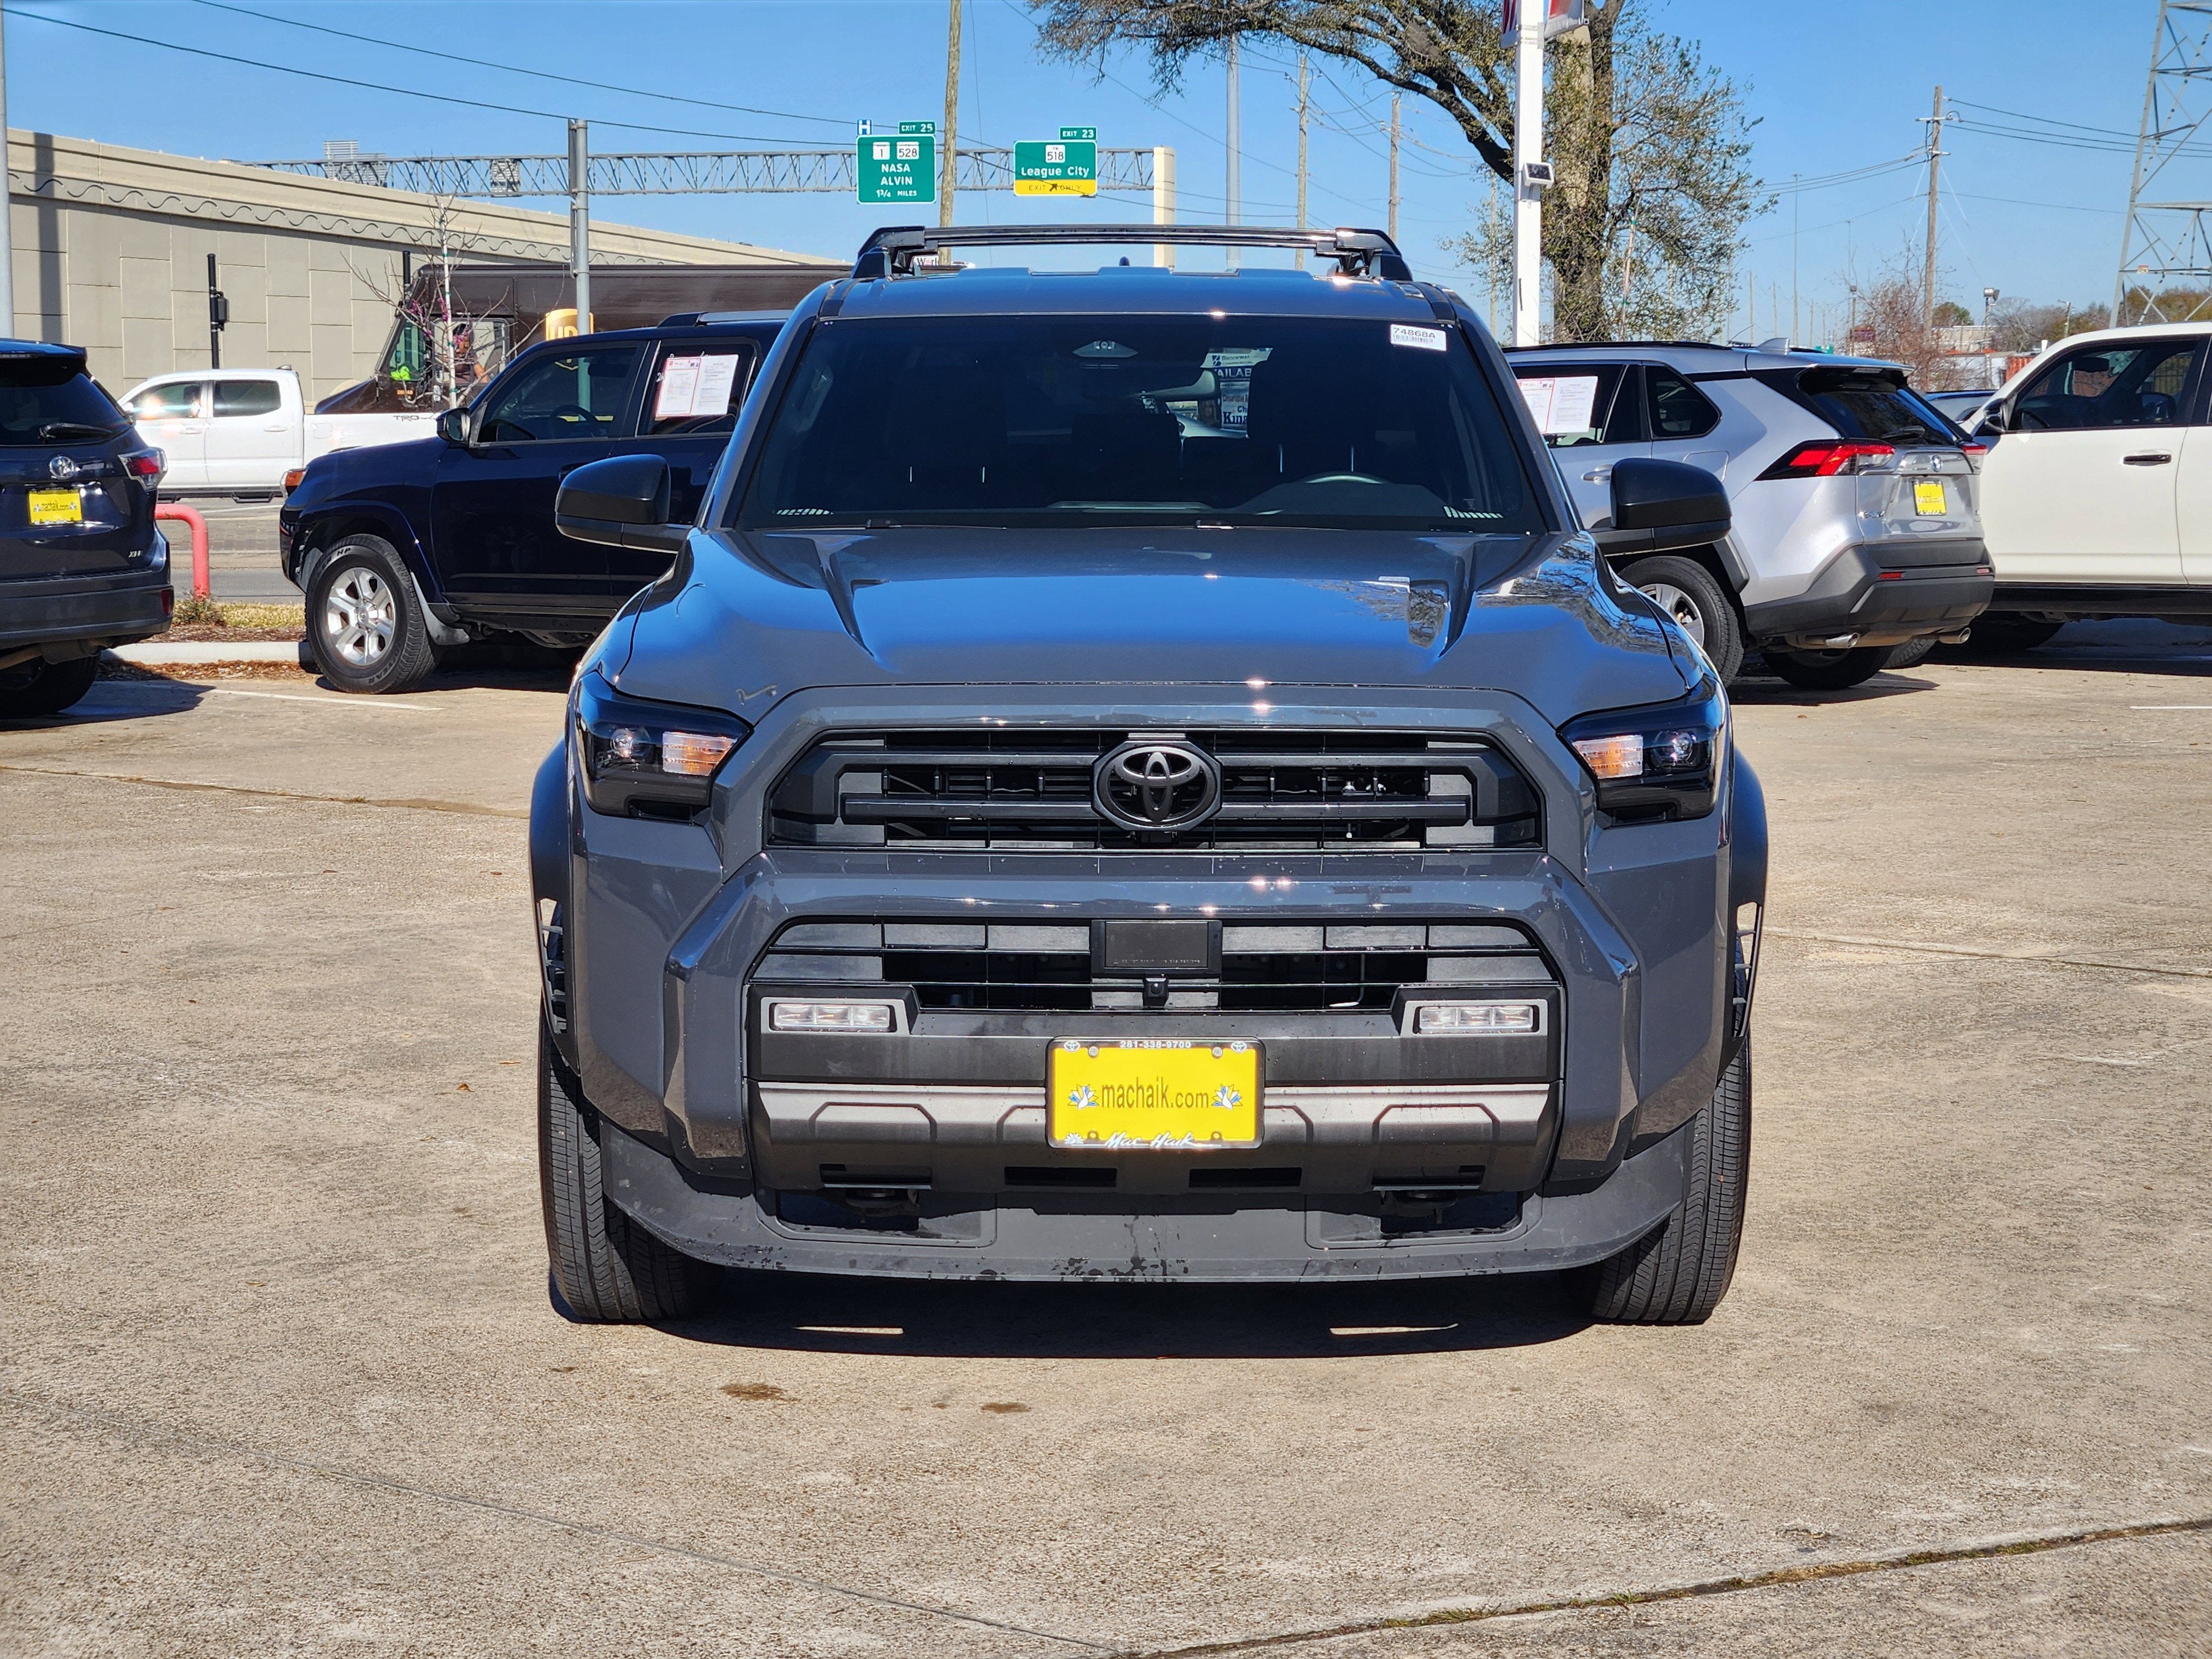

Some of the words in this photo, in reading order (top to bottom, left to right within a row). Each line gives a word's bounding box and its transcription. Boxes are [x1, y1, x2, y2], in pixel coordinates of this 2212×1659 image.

[920, 124, 933, 132] 25
[1082, 129, 1094, 138] 23
[899, 148, 917, 157] 528
[1047, 152, 1063, 160] 518
[881, 164, 910, 173] NASA
[1021, 167, 1062, 178] League
[1067, 166, 1089, 178] City
[880, 176, 912, 185] ALVIN
[1102, 1076, 1209, 1108] machaik.com
[1105, 1130, 1149, 1148] Mac
[1150, 1130, 1199, 1148] Haik
